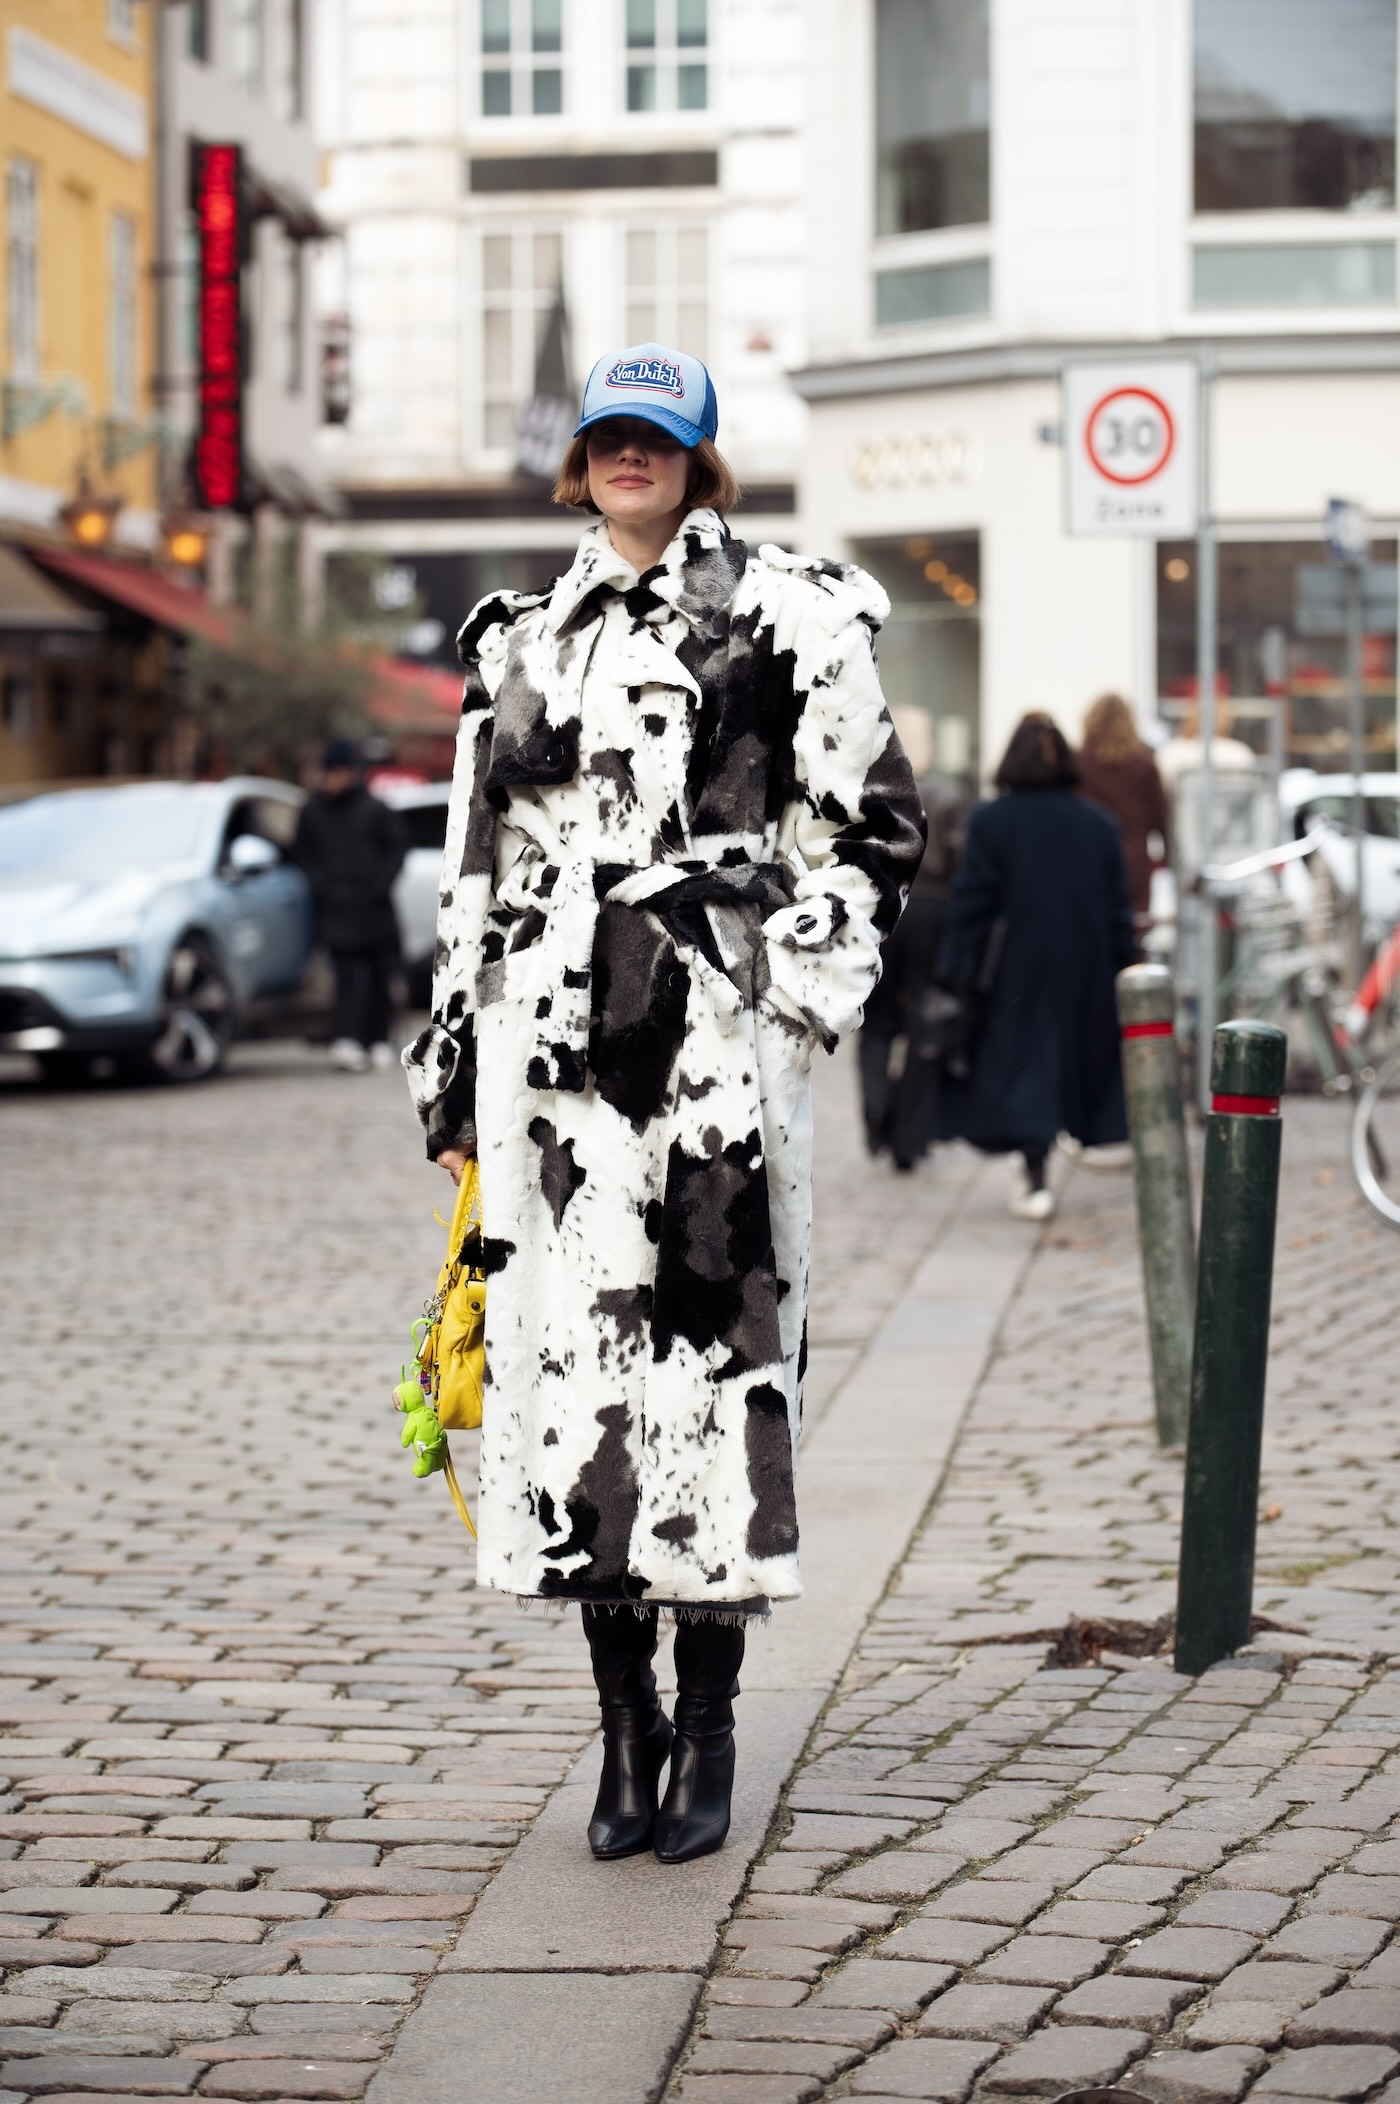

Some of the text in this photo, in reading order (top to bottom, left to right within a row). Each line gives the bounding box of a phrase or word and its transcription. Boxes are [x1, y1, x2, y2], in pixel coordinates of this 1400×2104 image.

[612, 361, 678, 388] Von Dutch
[1101, 417, 1159, 457] 30
